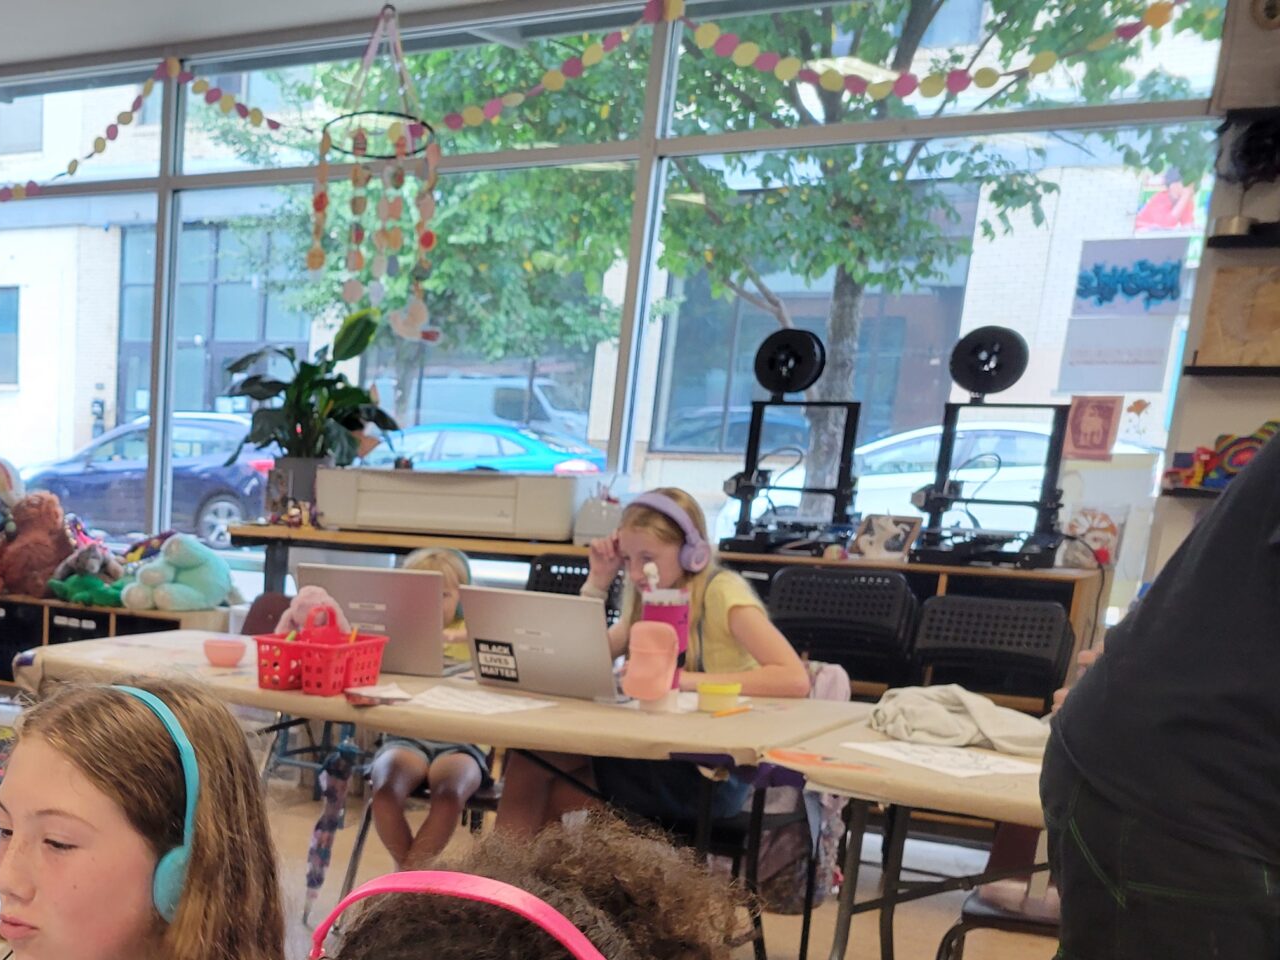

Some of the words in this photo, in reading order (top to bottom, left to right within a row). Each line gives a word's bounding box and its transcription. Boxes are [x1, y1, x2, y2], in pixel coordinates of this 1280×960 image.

[479, 644, 510, 654] BLACK
[485, 656, 509, 665] LIVES
[481, 666, 517, 677] MATTER
